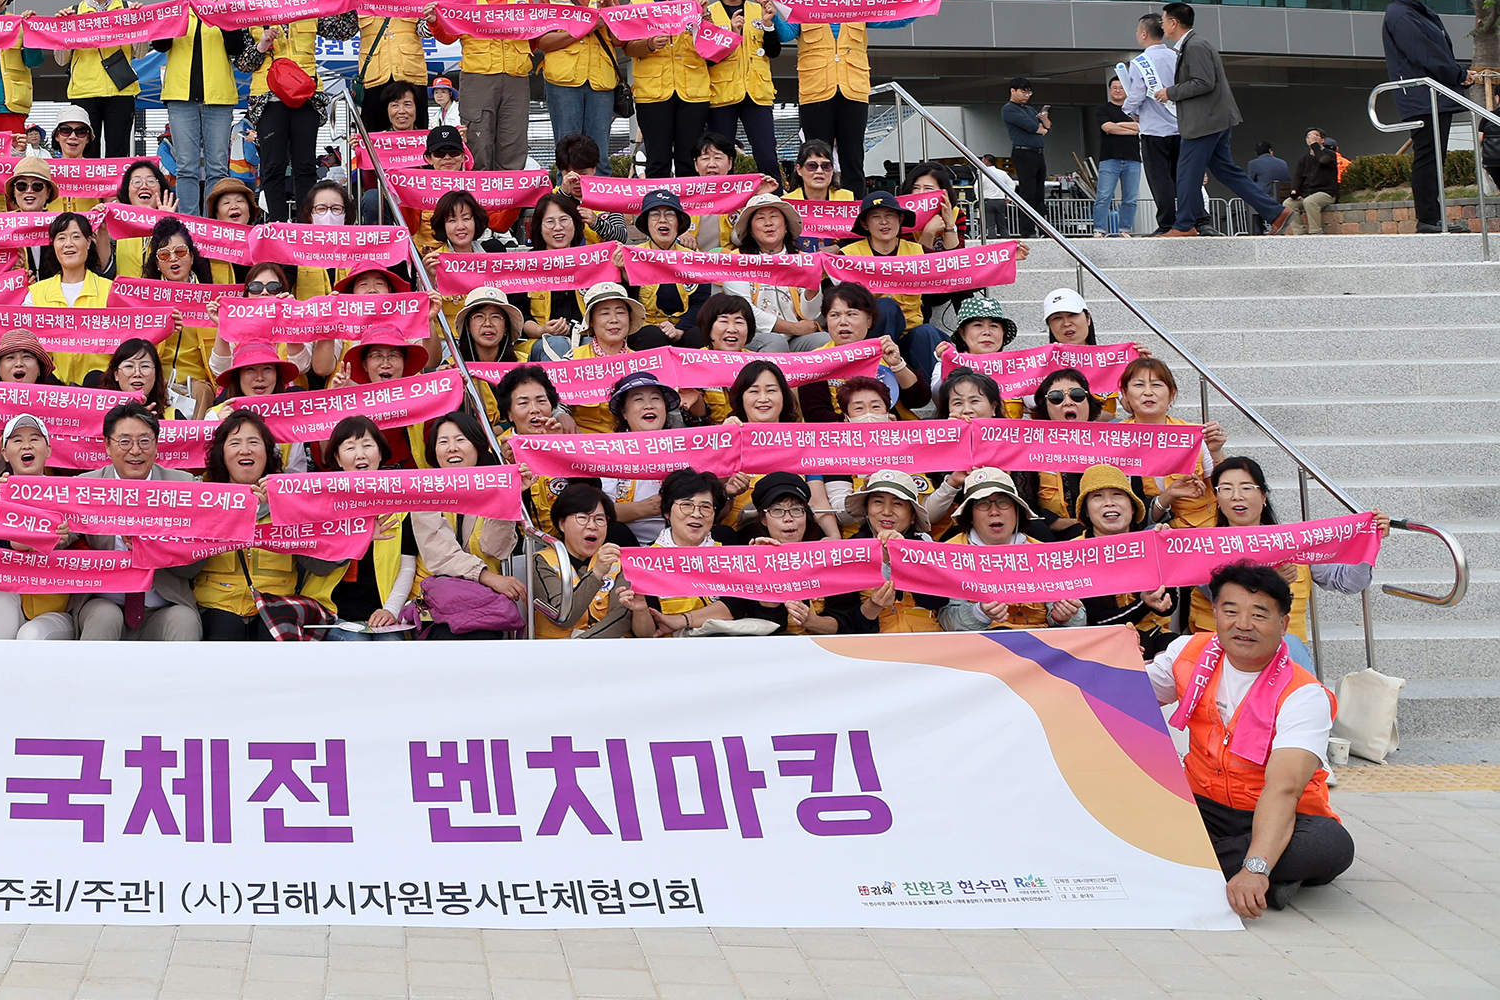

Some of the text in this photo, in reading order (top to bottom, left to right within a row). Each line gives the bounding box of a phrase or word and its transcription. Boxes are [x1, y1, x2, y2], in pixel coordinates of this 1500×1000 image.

[28, 4, 182, 33] 2024년 김해 전국체전, 자원봉사의 힘으로!
[879, 258, 931, 276] 전국체전
[934, 254, 972, 273] 김해로
[974, 248, 1011, 267] 오세요
[227, 299, 420, 319] 2024년 전국체전 김해로 오세요
[12, 312, 32, 328] 김해
[34, 313, 78, 331] 전국체전,
[80, 314, 131, 330] 자원봉사의
[134, 313, 168, 330] 힘으로!
[35, 390, 93, 410] 자원봉사의
[750, 426, 961, 448] 2024년 김해 전국체전, 자원봉사의 힘으로!
[980, 426, 1194, 449] 2024년 김해 전국체전, 자원봉사의 힘으로!
[276, 472, 512, 495] 2024년 김해 전국체전, 자원봉사의 힘으로!
[10, 483, 246, 511] 2024년 전국체전 김해로 오세요
[2, 512, 52, 534] 오세요
[627, 546, 871, 574] 2024년 김해 전국체전, 자원봉사의 힘으로!
[900, 540, 1145, 572] 2024년 김해 전국체전, 자원봉사의 힘으로!
[409, 730, 892, 842] 벤치마킹
[182, 878, 704, 915] (사)김해시자원봉사단체협의회
[902, 879, 1008, 896] 친환경 현수막
